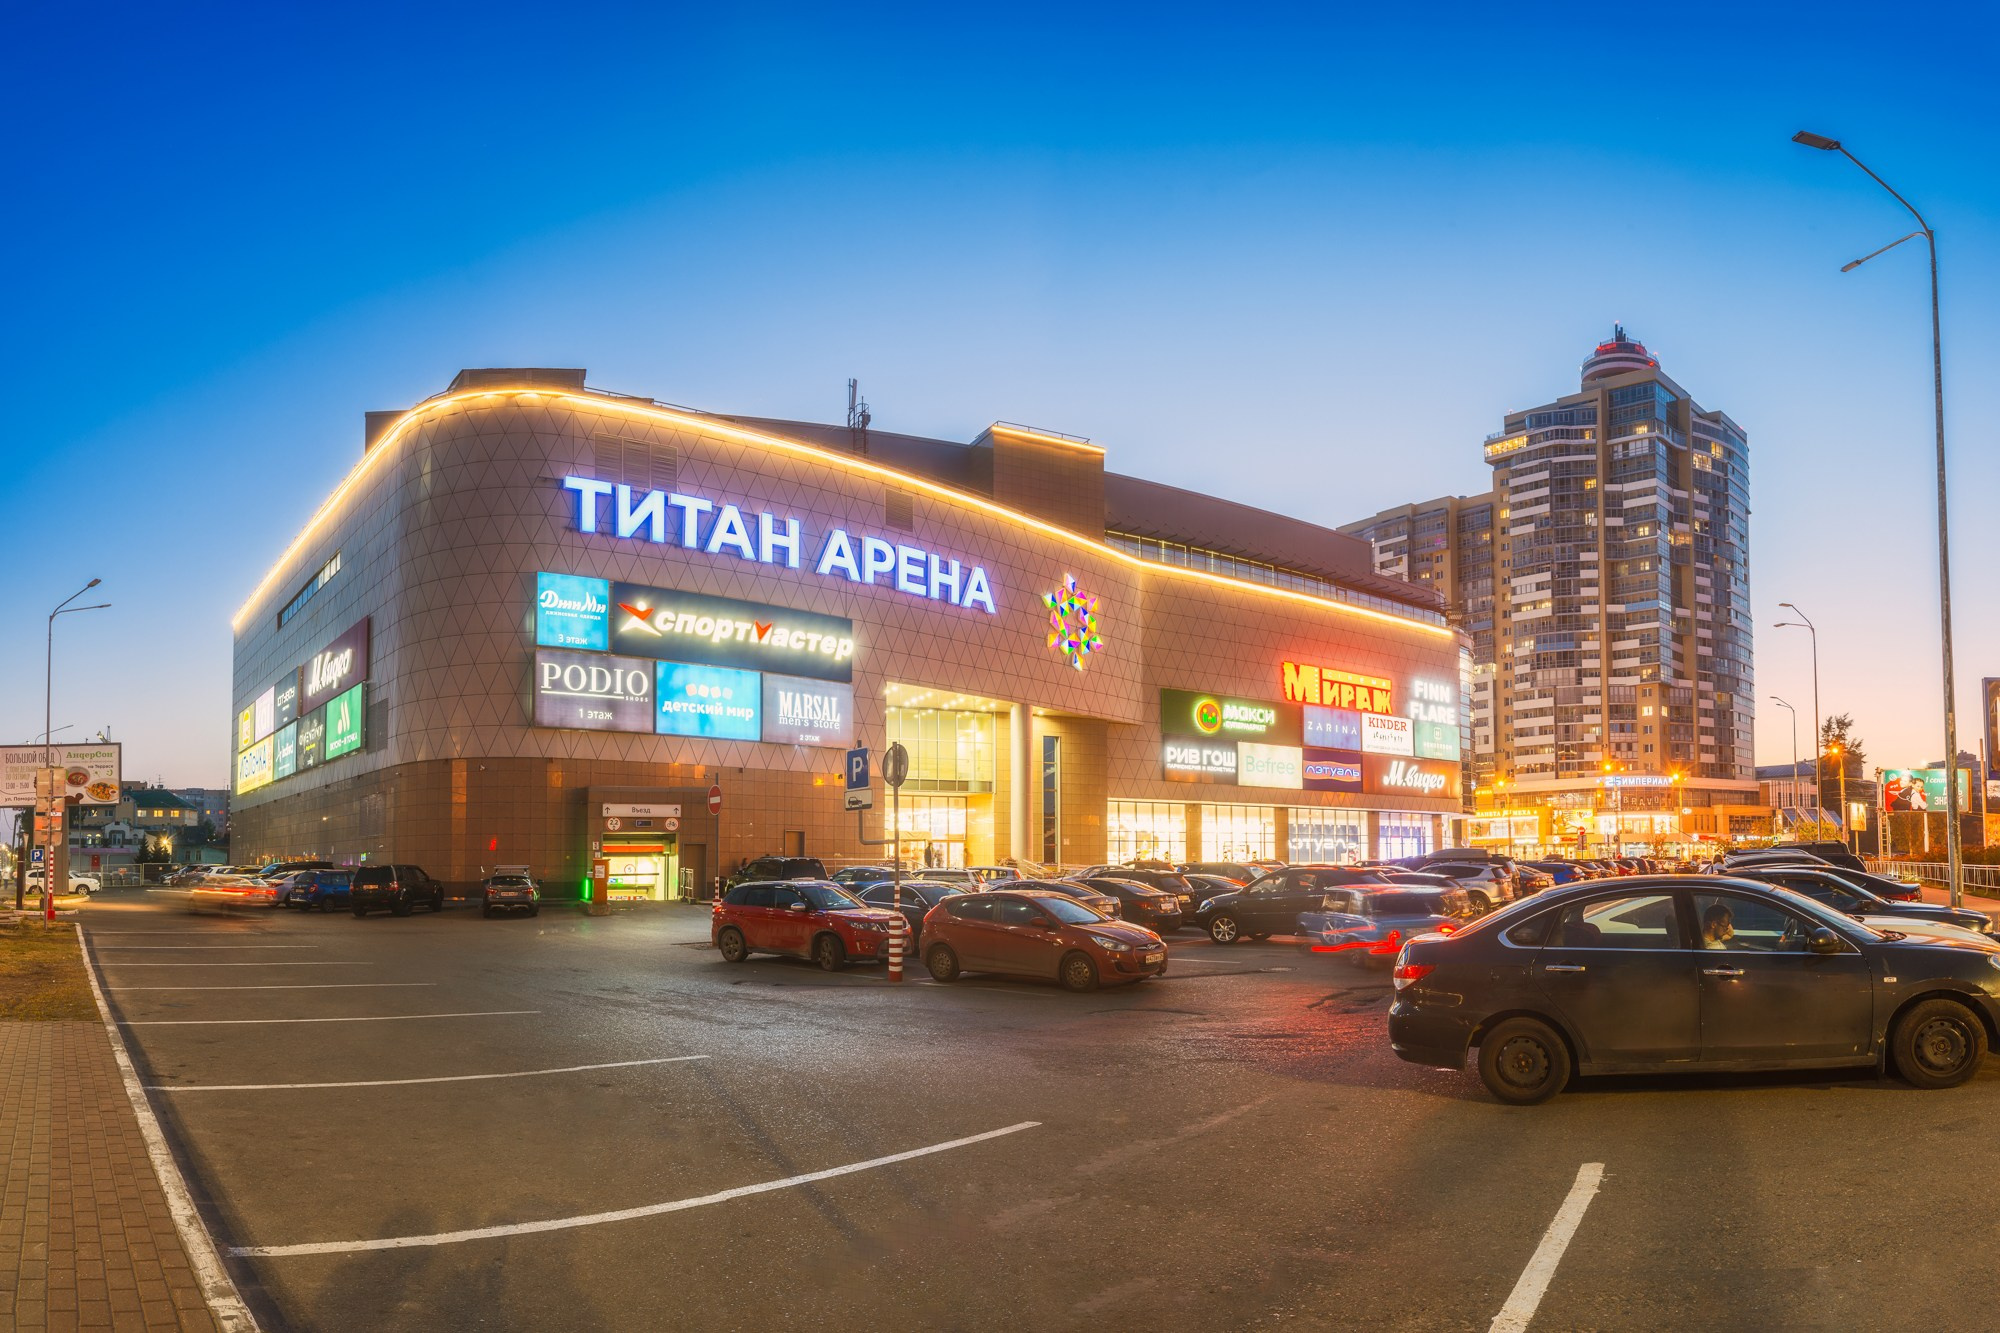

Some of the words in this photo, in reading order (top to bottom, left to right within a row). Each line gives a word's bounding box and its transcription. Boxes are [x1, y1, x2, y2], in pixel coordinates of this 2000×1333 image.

[563, 474, 801, 569] ТИТАН
[817, 528, 997, 614] АРЕНА
[558, 634, 564, 643] 3
[566, 636, 588, 645] этаж
[541, 662, 648, 697] PODIO
[625, 695, 649, 703] SHOES
[1414, 680, 1450, 703] FINN
[578, 708, 584, 718] 1
[588, 710, 613, 720] этаж
[662, 699, 724, 716] детский
[727, 706, 754, 721] мир
[778, 691, 841, 723] MARSAL
[1409, 701, 1456, 725] FLARE
[779, 716, 810, 727] men's
[813, 717, 840, 730] store
[1307, 721, 1358, 736] ZARINA
[1368, 717, 1408, 732] KINDER
[5, 751, 37, 764] БОЛЬШОЙ
[38, 752, 55, 764] ОБД
[66, 750, 113, 760] АндерСон
[1166, 746, 1200, 765] РИВ
[1203, 749, 1237, 768] ГОШ
[852, 757, 862, 782] P
[1245, 755, 1296, 775] Befree
[1622, 777, 1669, 786] ИМПЕРИАЛ
[631, 806, 651, 814] Въезд
